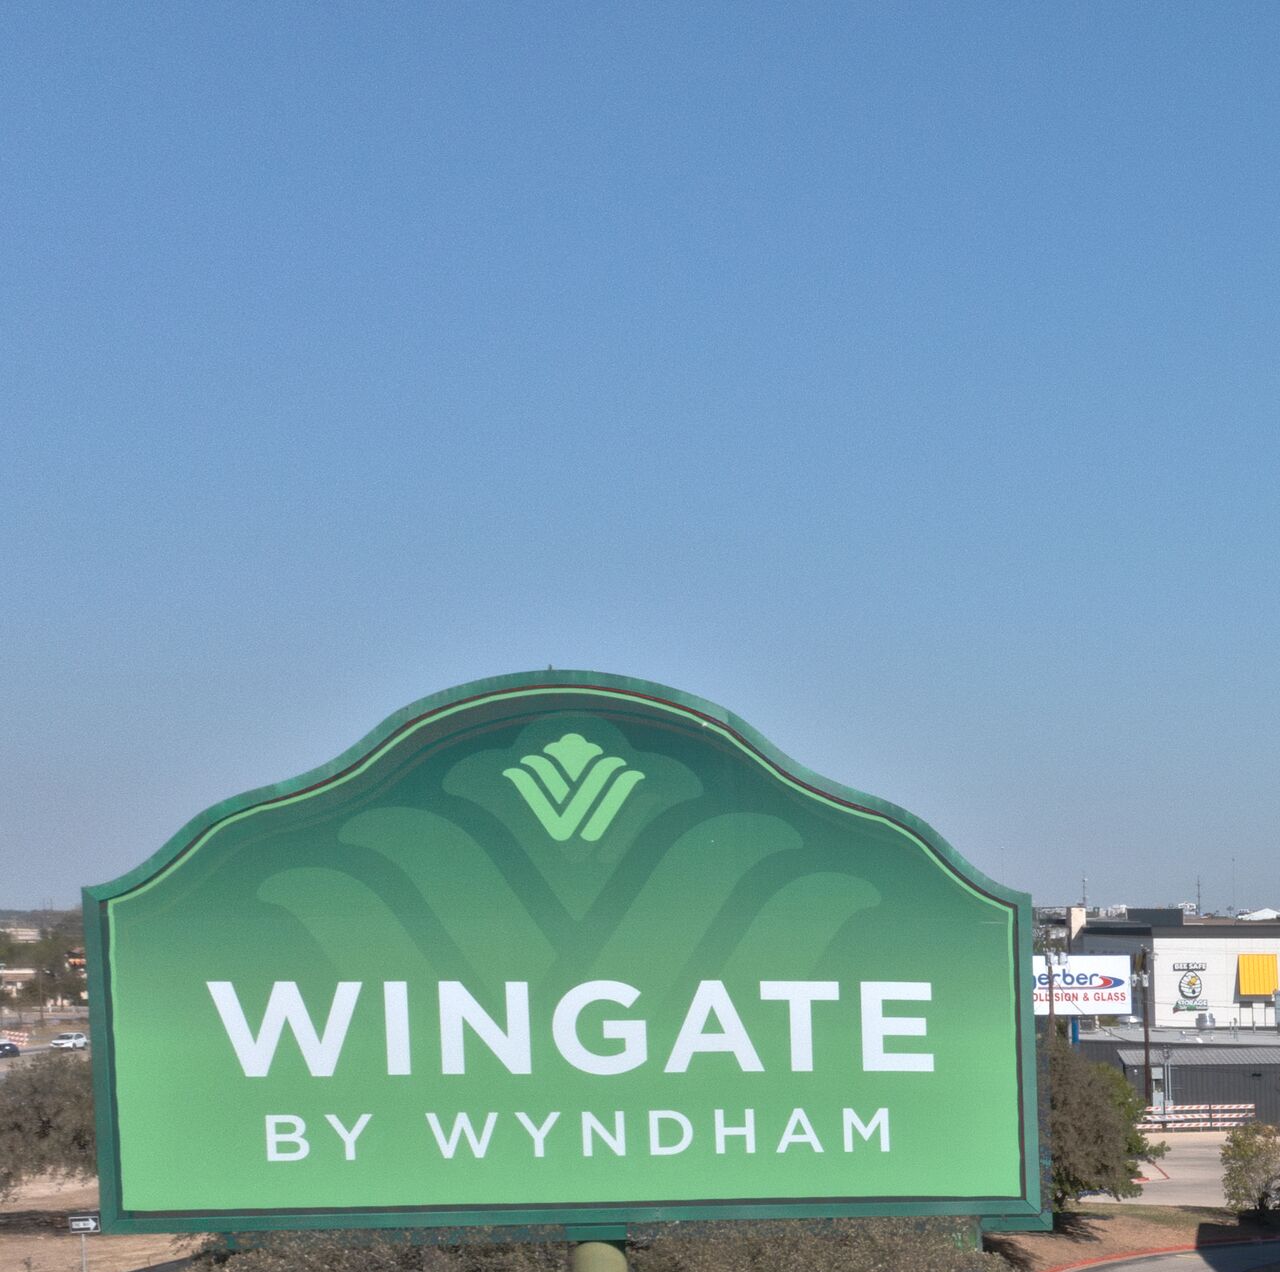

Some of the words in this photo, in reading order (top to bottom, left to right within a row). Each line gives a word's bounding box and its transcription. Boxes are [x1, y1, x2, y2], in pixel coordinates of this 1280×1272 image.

[1082, 992, 1090, 1001] &
[1093, 992, 1127, 1002] GLASS
[206, 979, 935, 1078] WINGATE
[265, 1113, 373, 1162] BY
[425, 1107, 891, 1159] WYNDHAM
